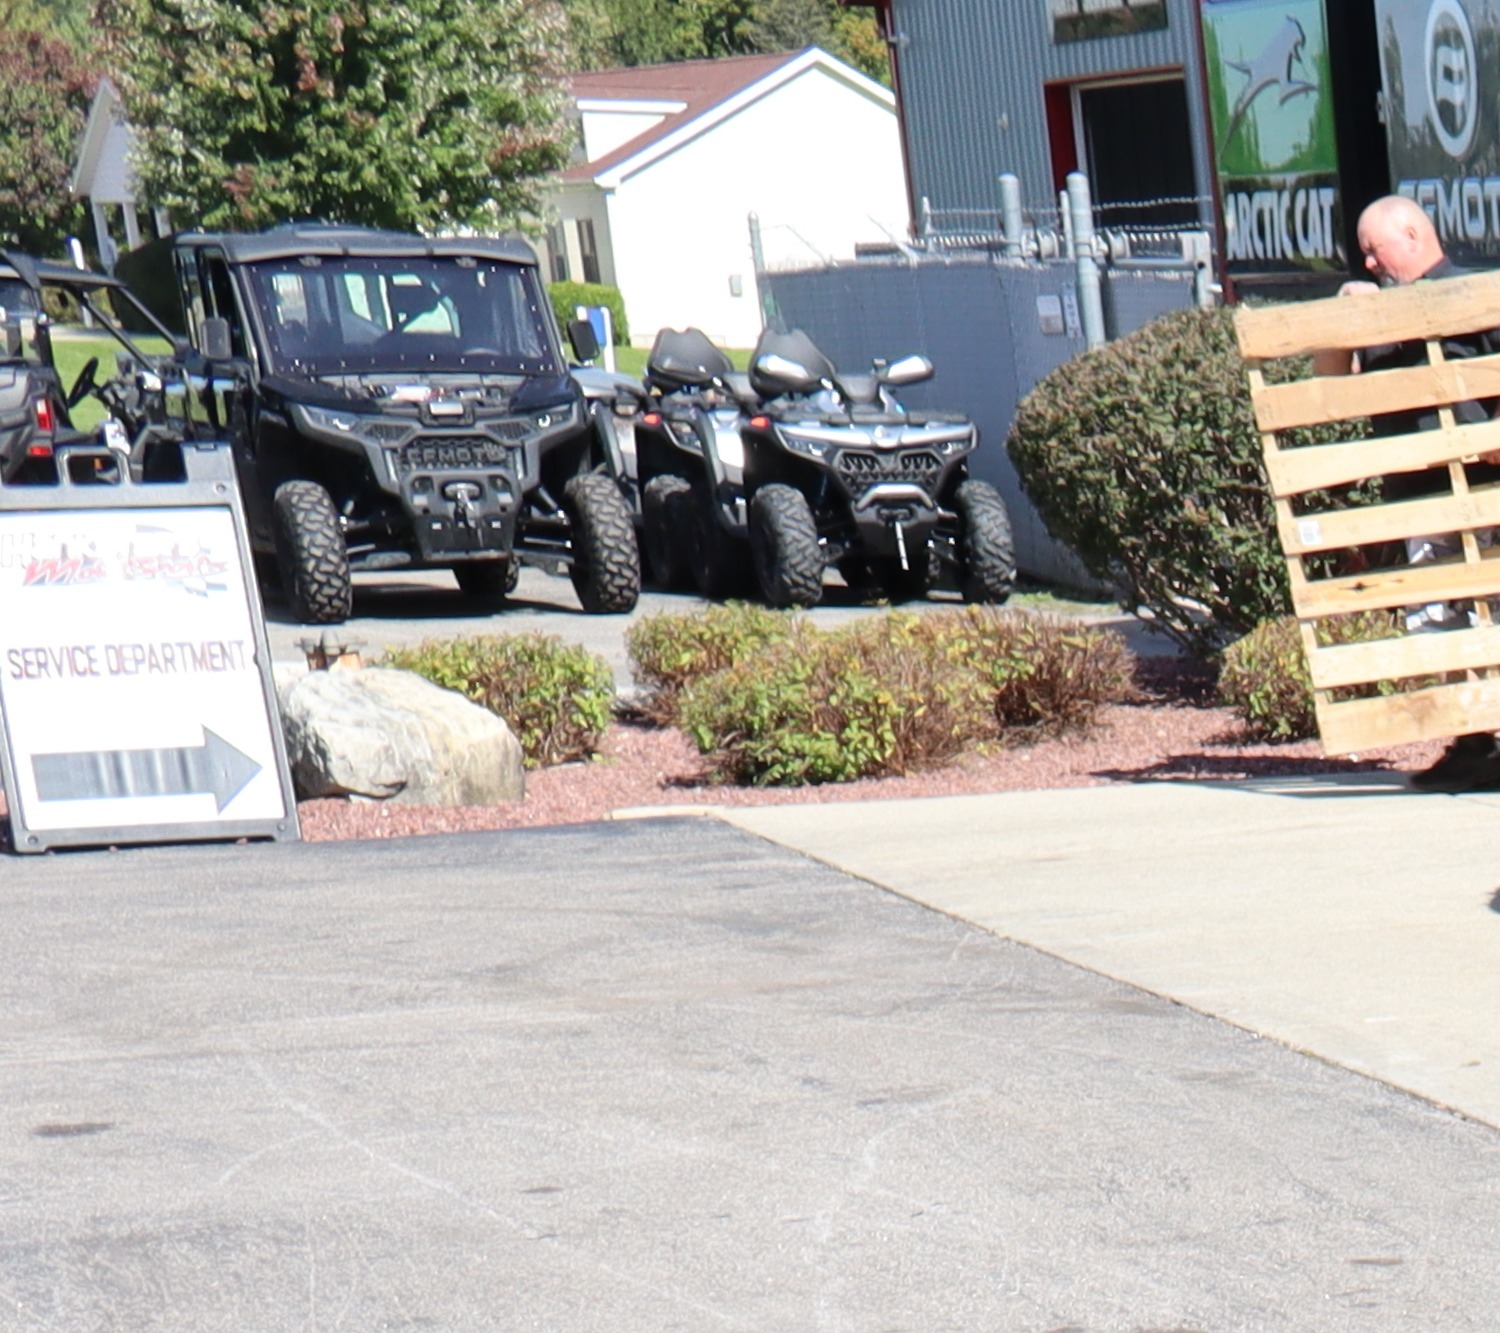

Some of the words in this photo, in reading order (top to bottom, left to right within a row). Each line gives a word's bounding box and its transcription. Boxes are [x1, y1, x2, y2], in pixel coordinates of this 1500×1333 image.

[1226, 188, 1294, 261] ARCTIC
[1294, 186, 1338, 260] CAT
[8, 645, 101, 680] SERVICE
[104, 640, 246, 677] DEPARTMENT
